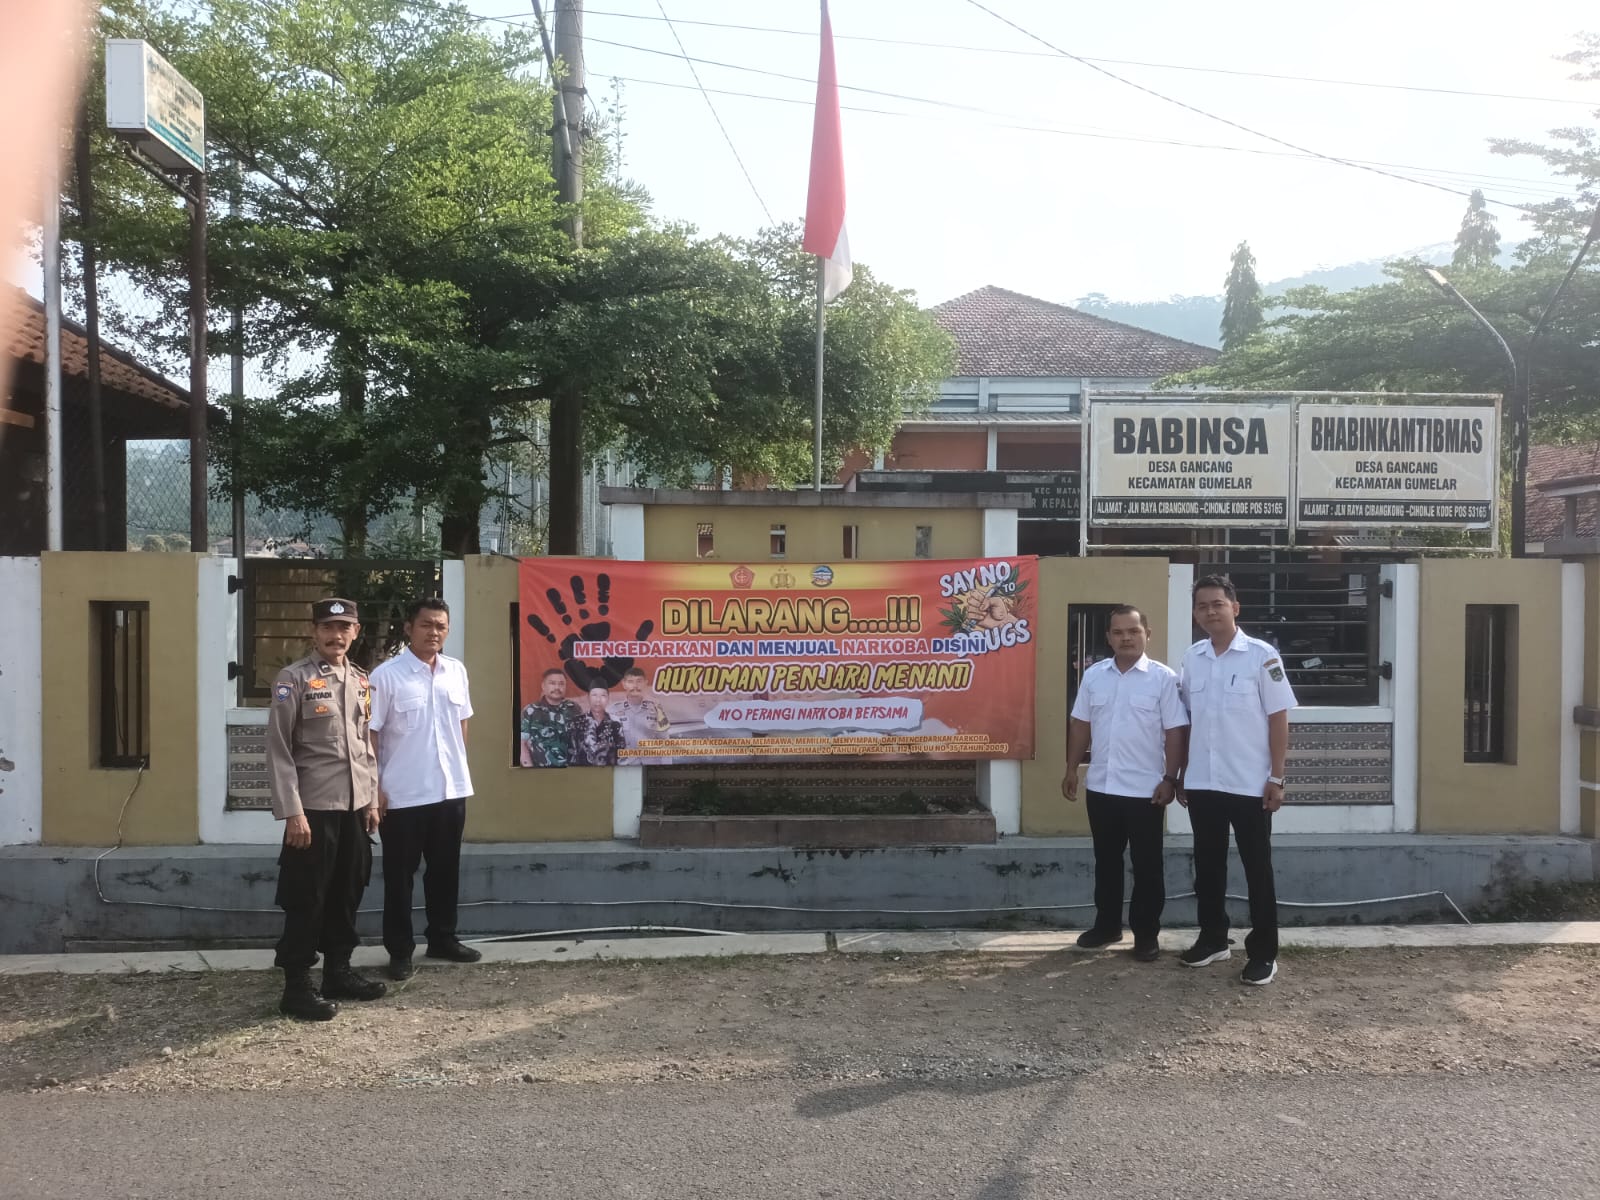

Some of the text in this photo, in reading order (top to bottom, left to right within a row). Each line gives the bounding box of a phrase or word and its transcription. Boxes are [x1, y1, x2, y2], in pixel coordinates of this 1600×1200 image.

[1113, 417, 1268, 455] BABINSA
[1311, 417, 1483, 453] BHABINKAMTIBMAS
[1148, 461, 1232, 473] DESA GANCANG
[1355, 461, 1438, 474] DESA GANCANG
[1128, 477, 1252, 489] KECAMATAN GUMELAR
[1335, 477, 1457, 490] KECAMATAN GUMELAR
[1097, 502, 1122, 514] ALAMAT
[1128, 502, 1139, 513] JLN
[1141, 502, 1157, 513] RAYA
[1158, 502, 1199, 514] CIBANGKONG
[1232, 502, 1249, 514] KODE
[1250, 502, 1263, 514] POS
[1264, 502, 1282, 514] 53165
[1304, 504, 1329, 515] ALAMAT
[1347, 505, 1363, 516] RAYA
[1436, 505, 1452, 517] KODE
[1454, 506, 1467, 517] POS
[1468, 506, 1487, 518] 53165
[940, 561, 1011, 597] SAY NO
[1003, 582, 1016, 592] TO
[574, 639, 986, 657] MENGEDARKAN DAN MENJUAL NARKOBA DISINI
[655, 661, 971, 693] HUKUMAN PENJARA MENANTI
[718, 705, 908, 721] AYO PERANGI NARKOBA BERSAMA
[665, 739, 690, 747] ORANG
